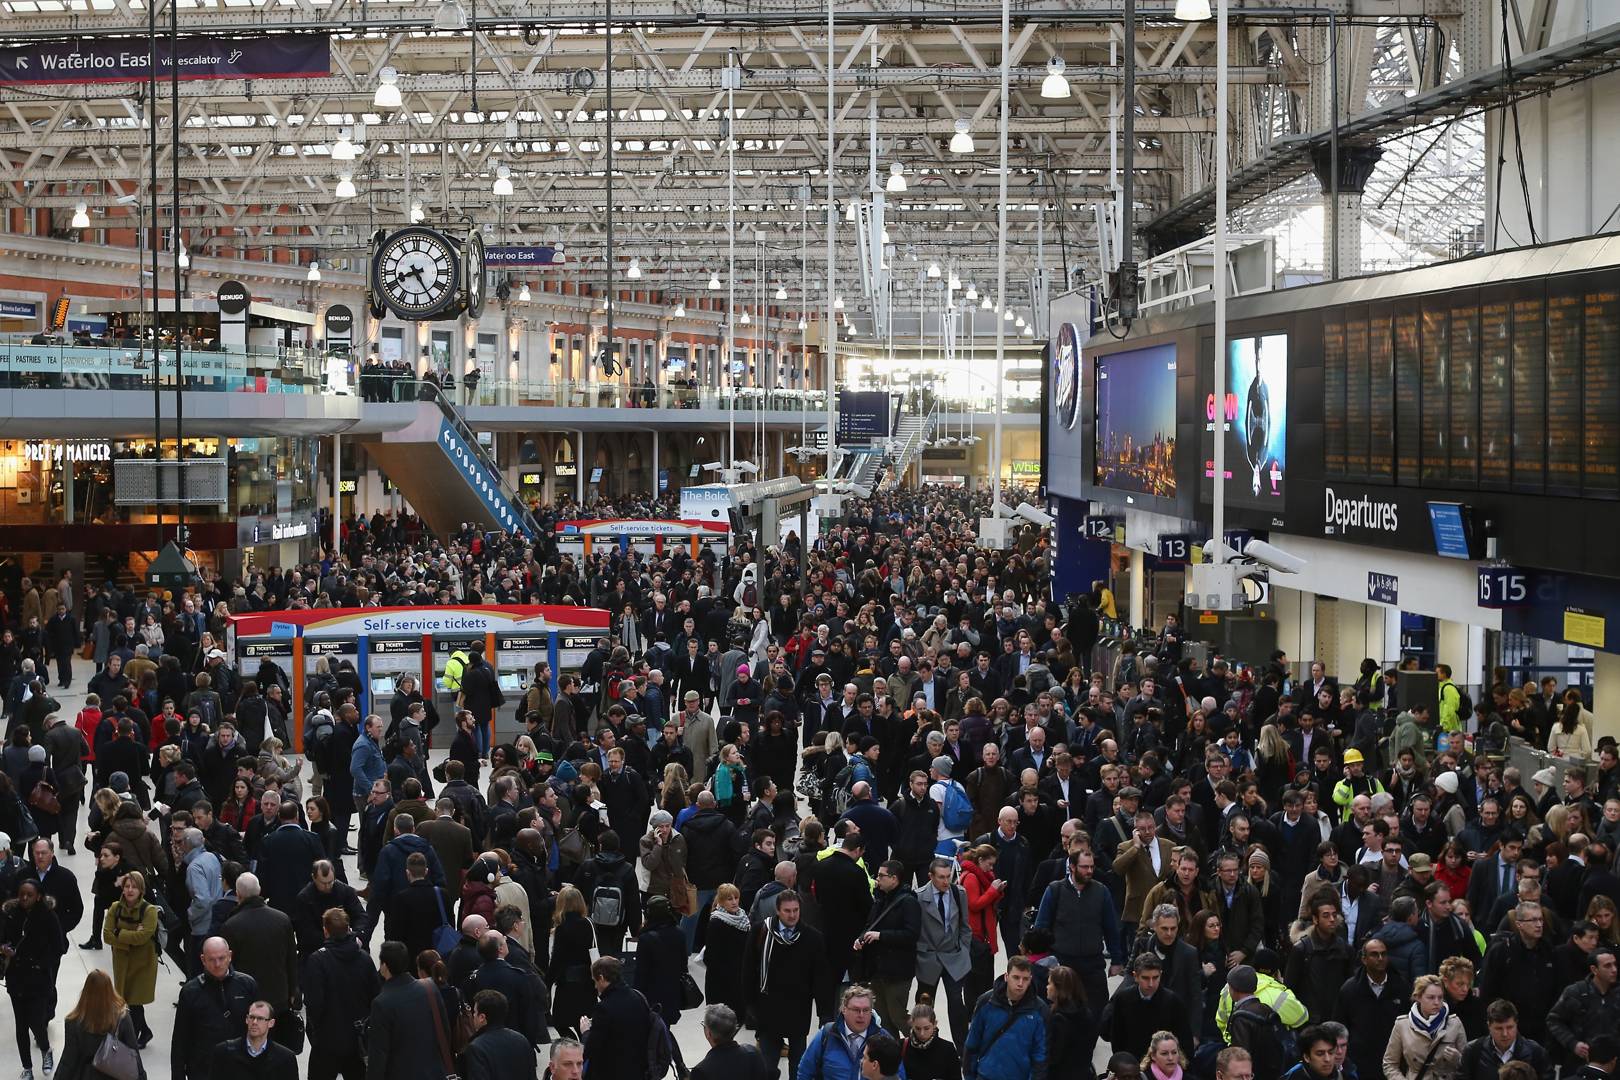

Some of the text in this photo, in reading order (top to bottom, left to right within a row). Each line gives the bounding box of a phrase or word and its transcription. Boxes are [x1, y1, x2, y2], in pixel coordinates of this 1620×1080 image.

[40, 52, 221, 70] Waterloo East via escalator
[1207, 394, 1238, 420] GMM
[25, 444, 50, 461] PRET
[66, 444, 110, 461] MANGER
[682, 490, 701, 500] The
[1326, 488, 1397, 534] Departures
[273, 524, 282, 540] Rail
[283, 521, 306, 538] information
[1090, 520, 1107, 537] 12
[1165, 540, 1185, 558] 13
[1480, 574, 1490, 600] 15
[1498, 576, 1526, 600] 15
[364, 618, 487, 630] Self-service tickets
